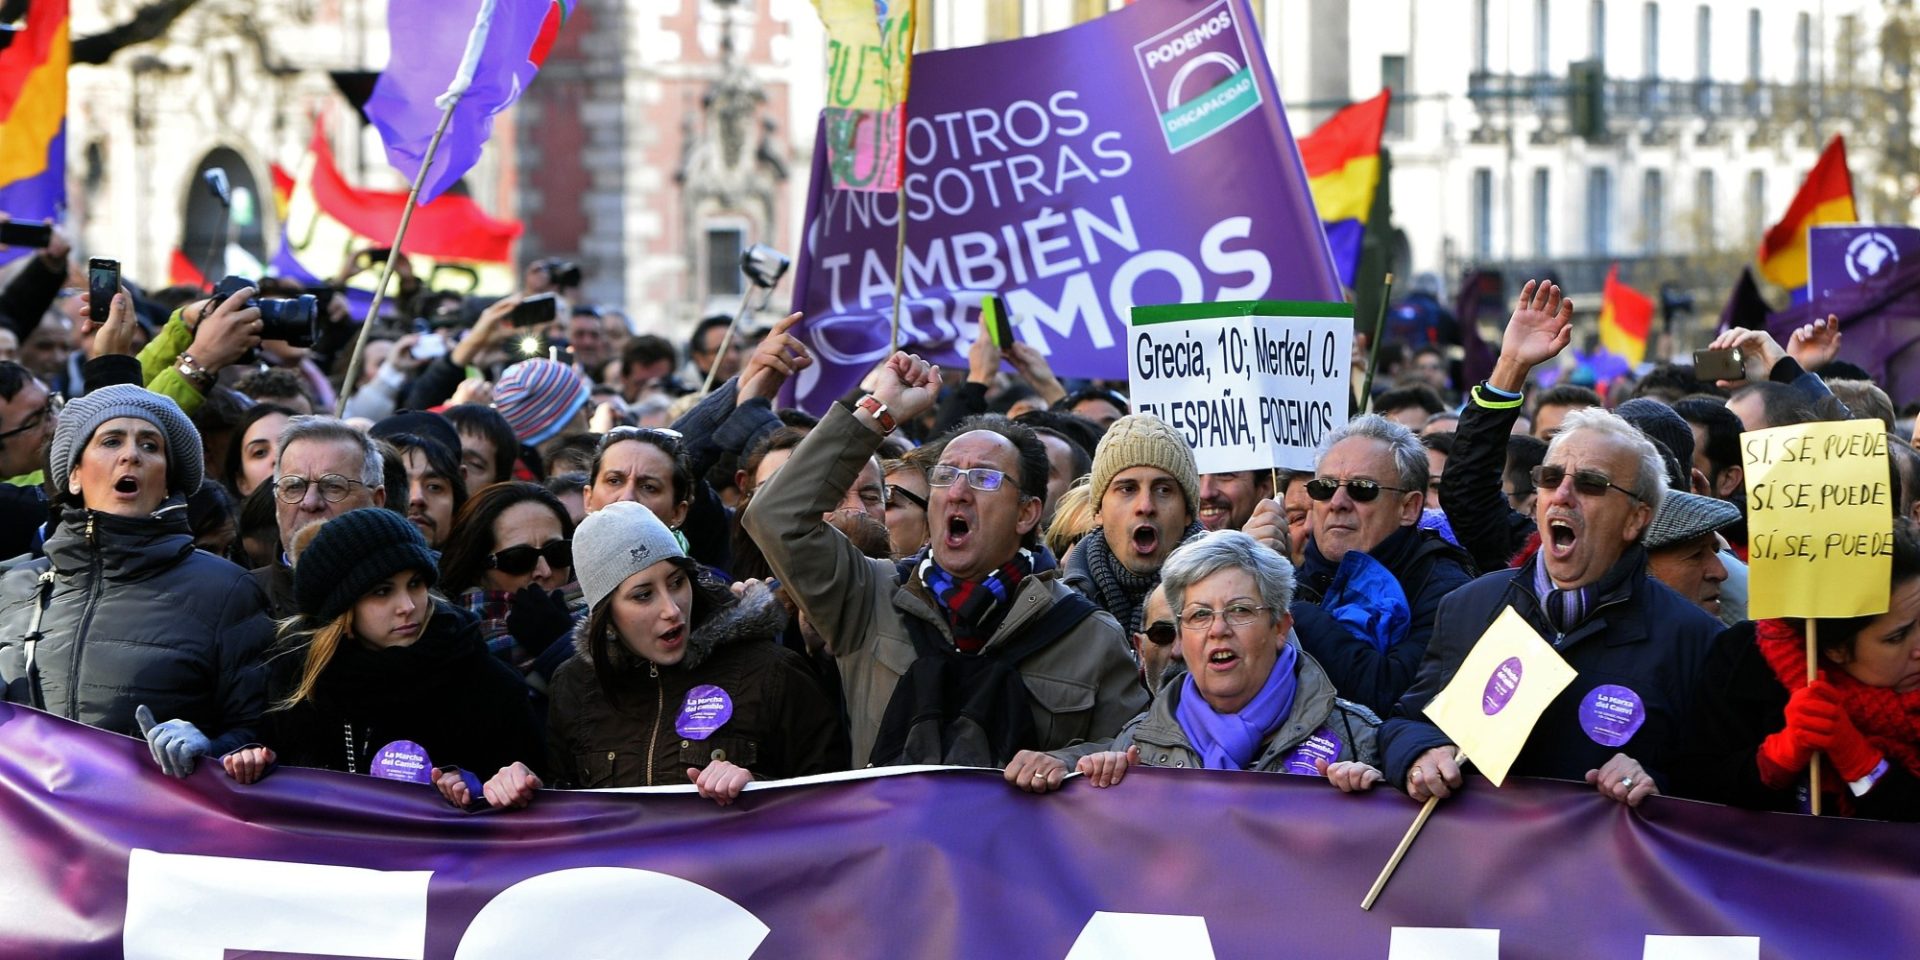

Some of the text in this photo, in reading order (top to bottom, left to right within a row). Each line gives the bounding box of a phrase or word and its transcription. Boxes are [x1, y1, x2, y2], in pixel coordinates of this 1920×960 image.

[1145, 10, 1232, 69] PODEMOS
[905, 90, 1089, 165] OTROS
[1166, 78, 1251, 132] DISCAPACIDAD
[845, 131, 1132, 232] NOSOTRAS
[822, 194, 1141, 314] TAMBIÉN
[1136, 326, 1339, 385] Grecia, 10; Merkel, 0.
[1171, 388, 1333, 453] ESPAÑA, PODEMOS
[1777, 436, 1816, 466] SE,
[1823, 432, 1889, 460] PUEDE
[1783, 483, 1816, 514] SE,
[1820, 482, 1887, 510] PUEDE
[1783, 534, 1817, 562] SE,
[1824, 532, 1894, 559] PUEDE
[381, 758, 425, 770] del Cambio
[384, 751, 423, 762] La Marcha
